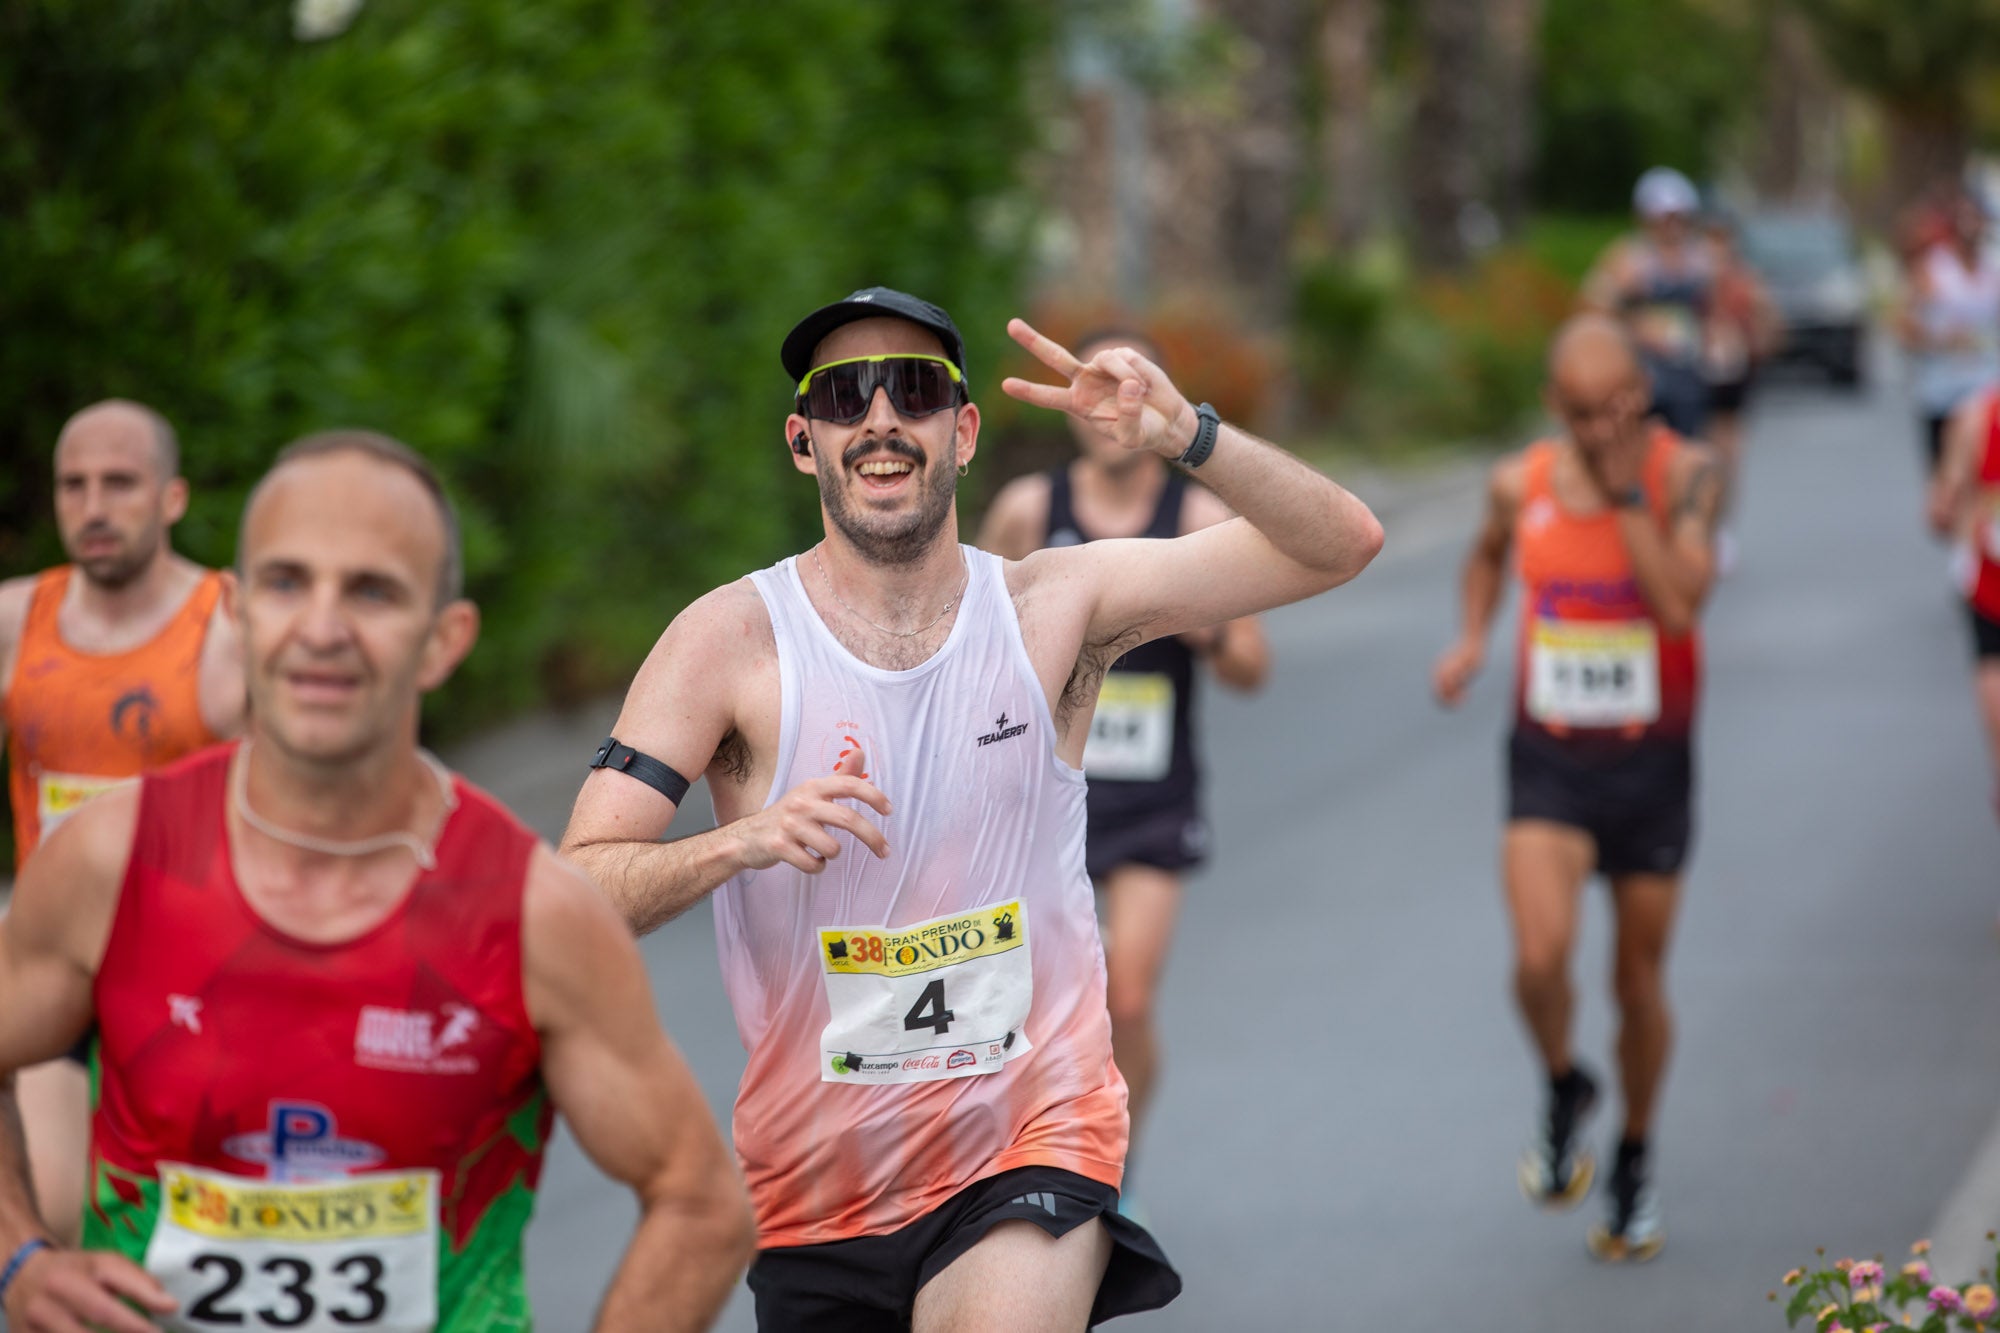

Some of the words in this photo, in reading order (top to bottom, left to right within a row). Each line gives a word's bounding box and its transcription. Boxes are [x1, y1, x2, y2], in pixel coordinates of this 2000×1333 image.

[851, 936, 883, 963] 38
[883, 929, 985, 967] FONDO
[885, 933, 919, 947] GRAN
[922, 920, 971, 940] PREMIO
[904, 978, 955, 1035] 4
[186, 1253, 388, 1328] 233
